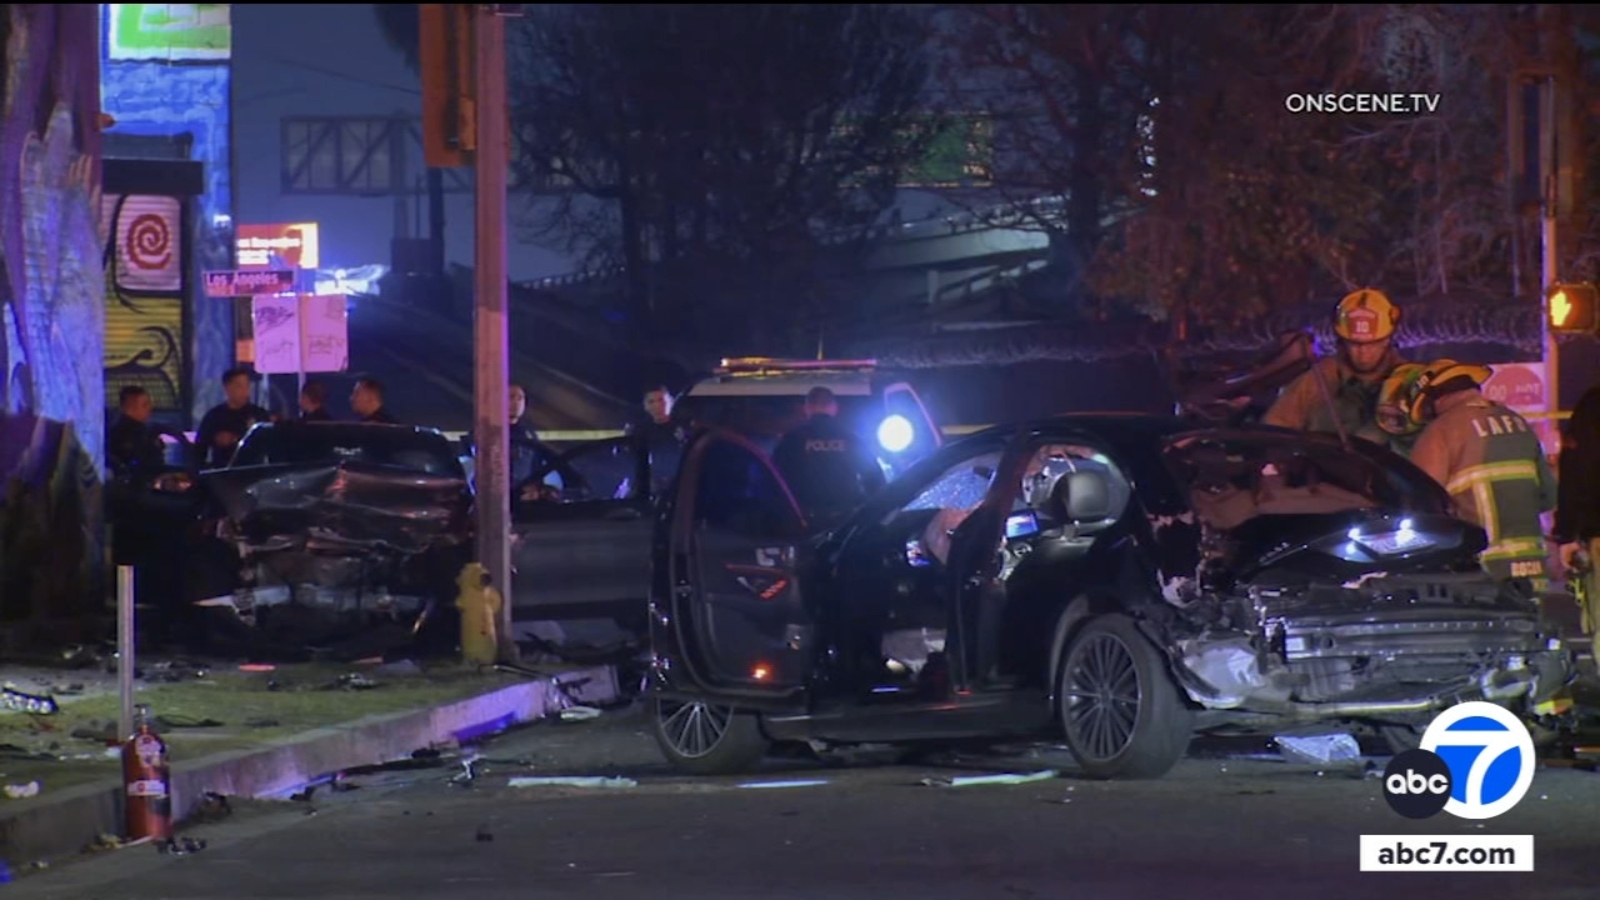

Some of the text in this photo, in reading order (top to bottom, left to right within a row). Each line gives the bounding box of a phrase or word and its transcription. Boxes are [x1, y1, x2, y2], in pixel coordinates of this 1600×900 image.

[206, 271, 279, 288] Los Angeles
[805, 439, 846, 452] POLICE
